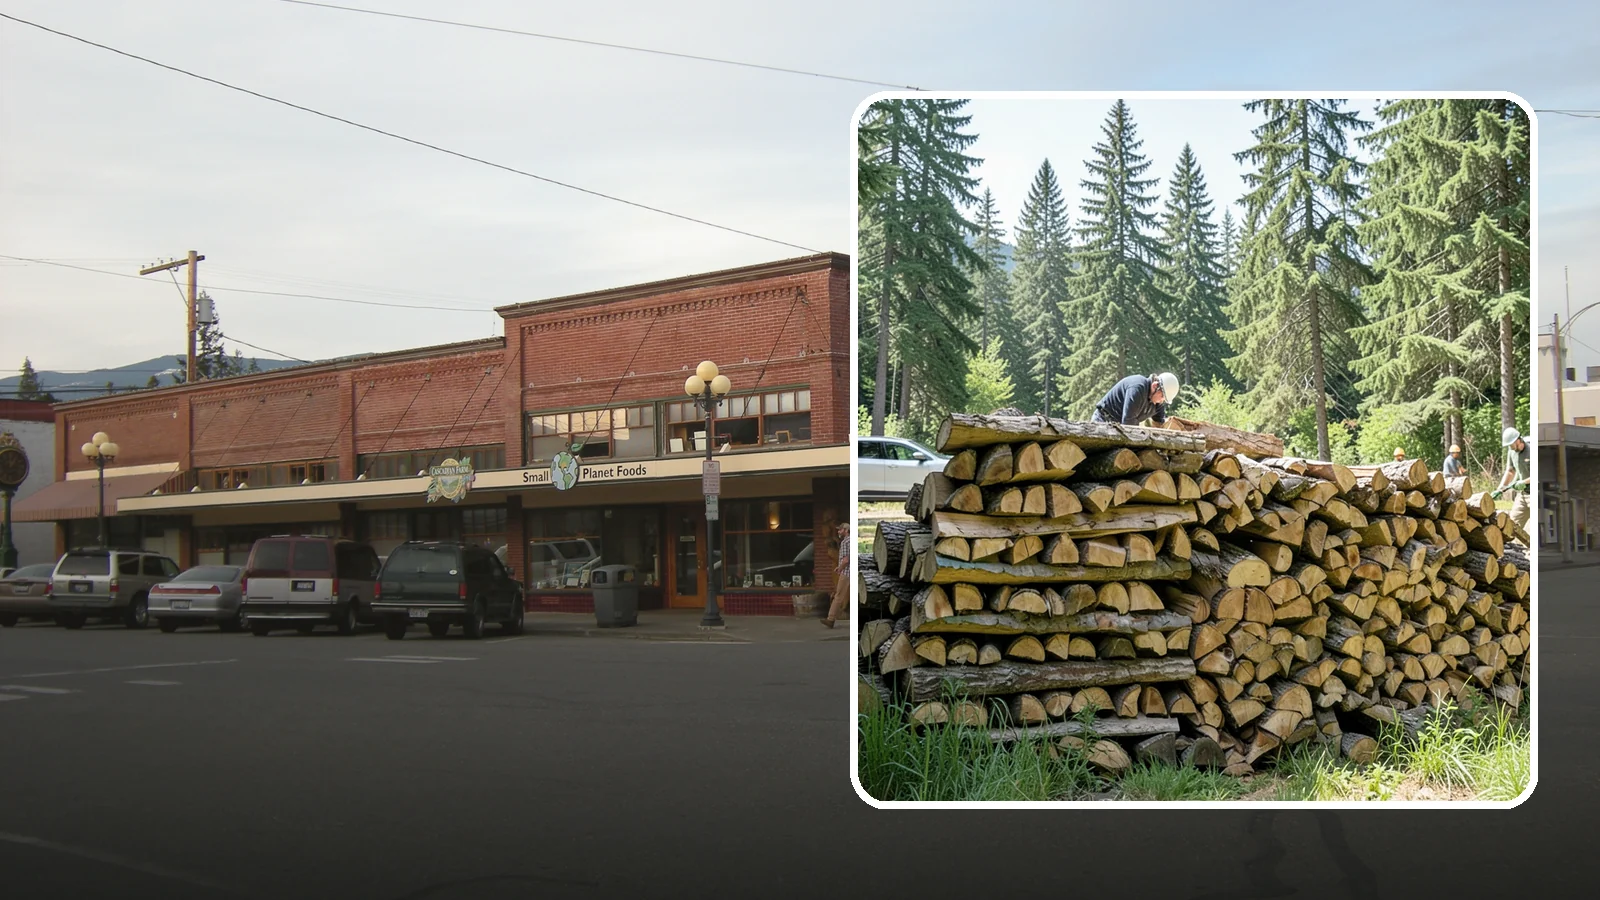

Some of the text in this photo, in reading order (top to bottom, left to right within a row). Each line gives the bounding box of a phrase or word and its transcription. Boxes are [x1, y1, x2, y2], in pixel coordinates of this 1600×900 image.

[523, 464, 647, 483] Small Planet Foods
